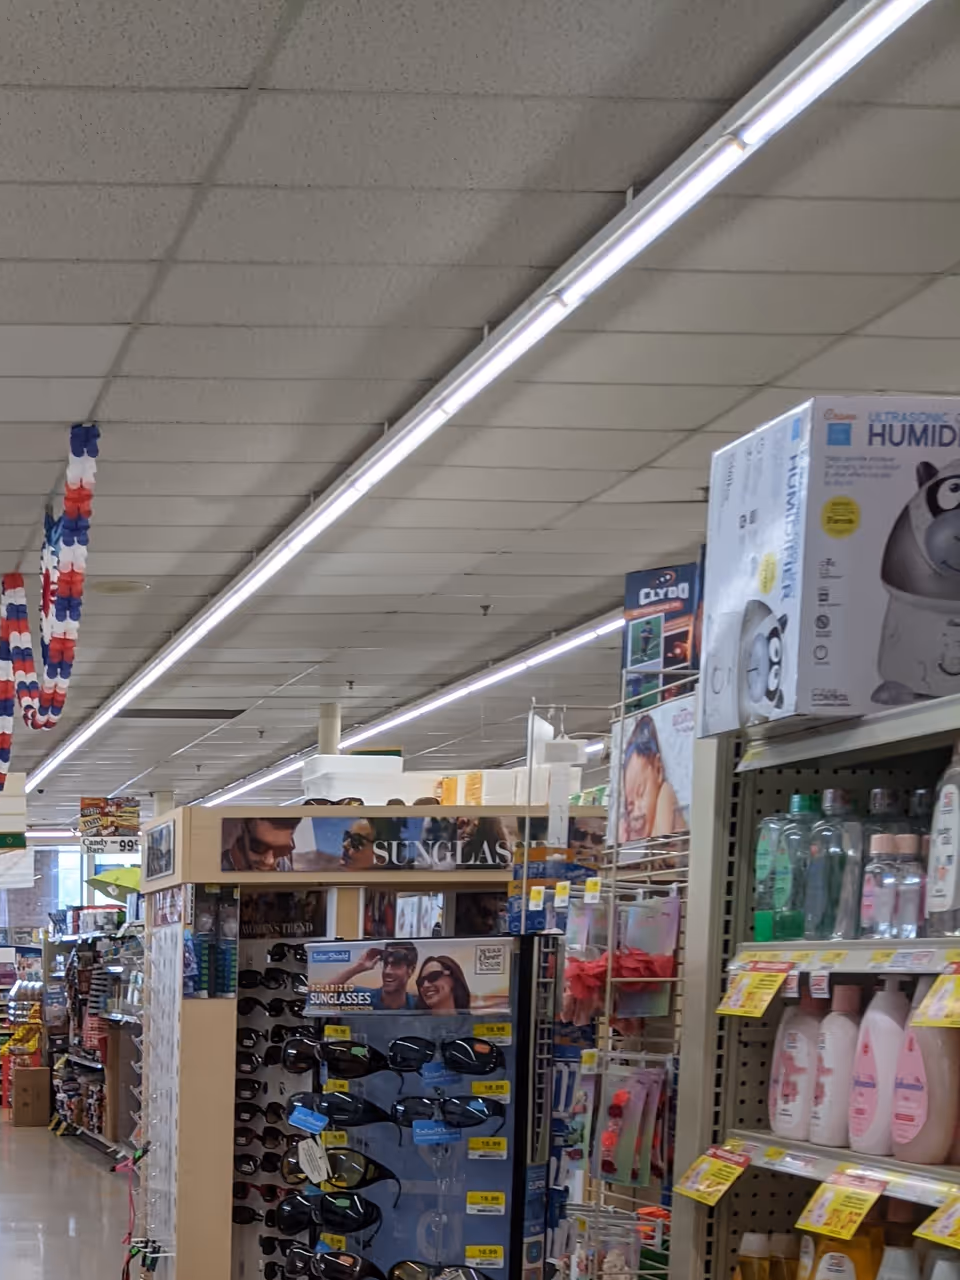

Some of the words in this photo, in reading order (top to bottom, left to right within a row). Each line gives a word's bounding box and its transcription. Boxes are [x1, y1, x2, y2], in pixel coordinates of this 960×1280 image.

[868, 411, 948, 424] ULTRASONIC
[82, 838, 108, 848] Candy
[87, 846, 105, 854] Bars
[372, 839, 515, 867] SUNGLAS
[282, 922, 314, 934] TREND
[310, 992, 372, 1004] SUNGLASSES
